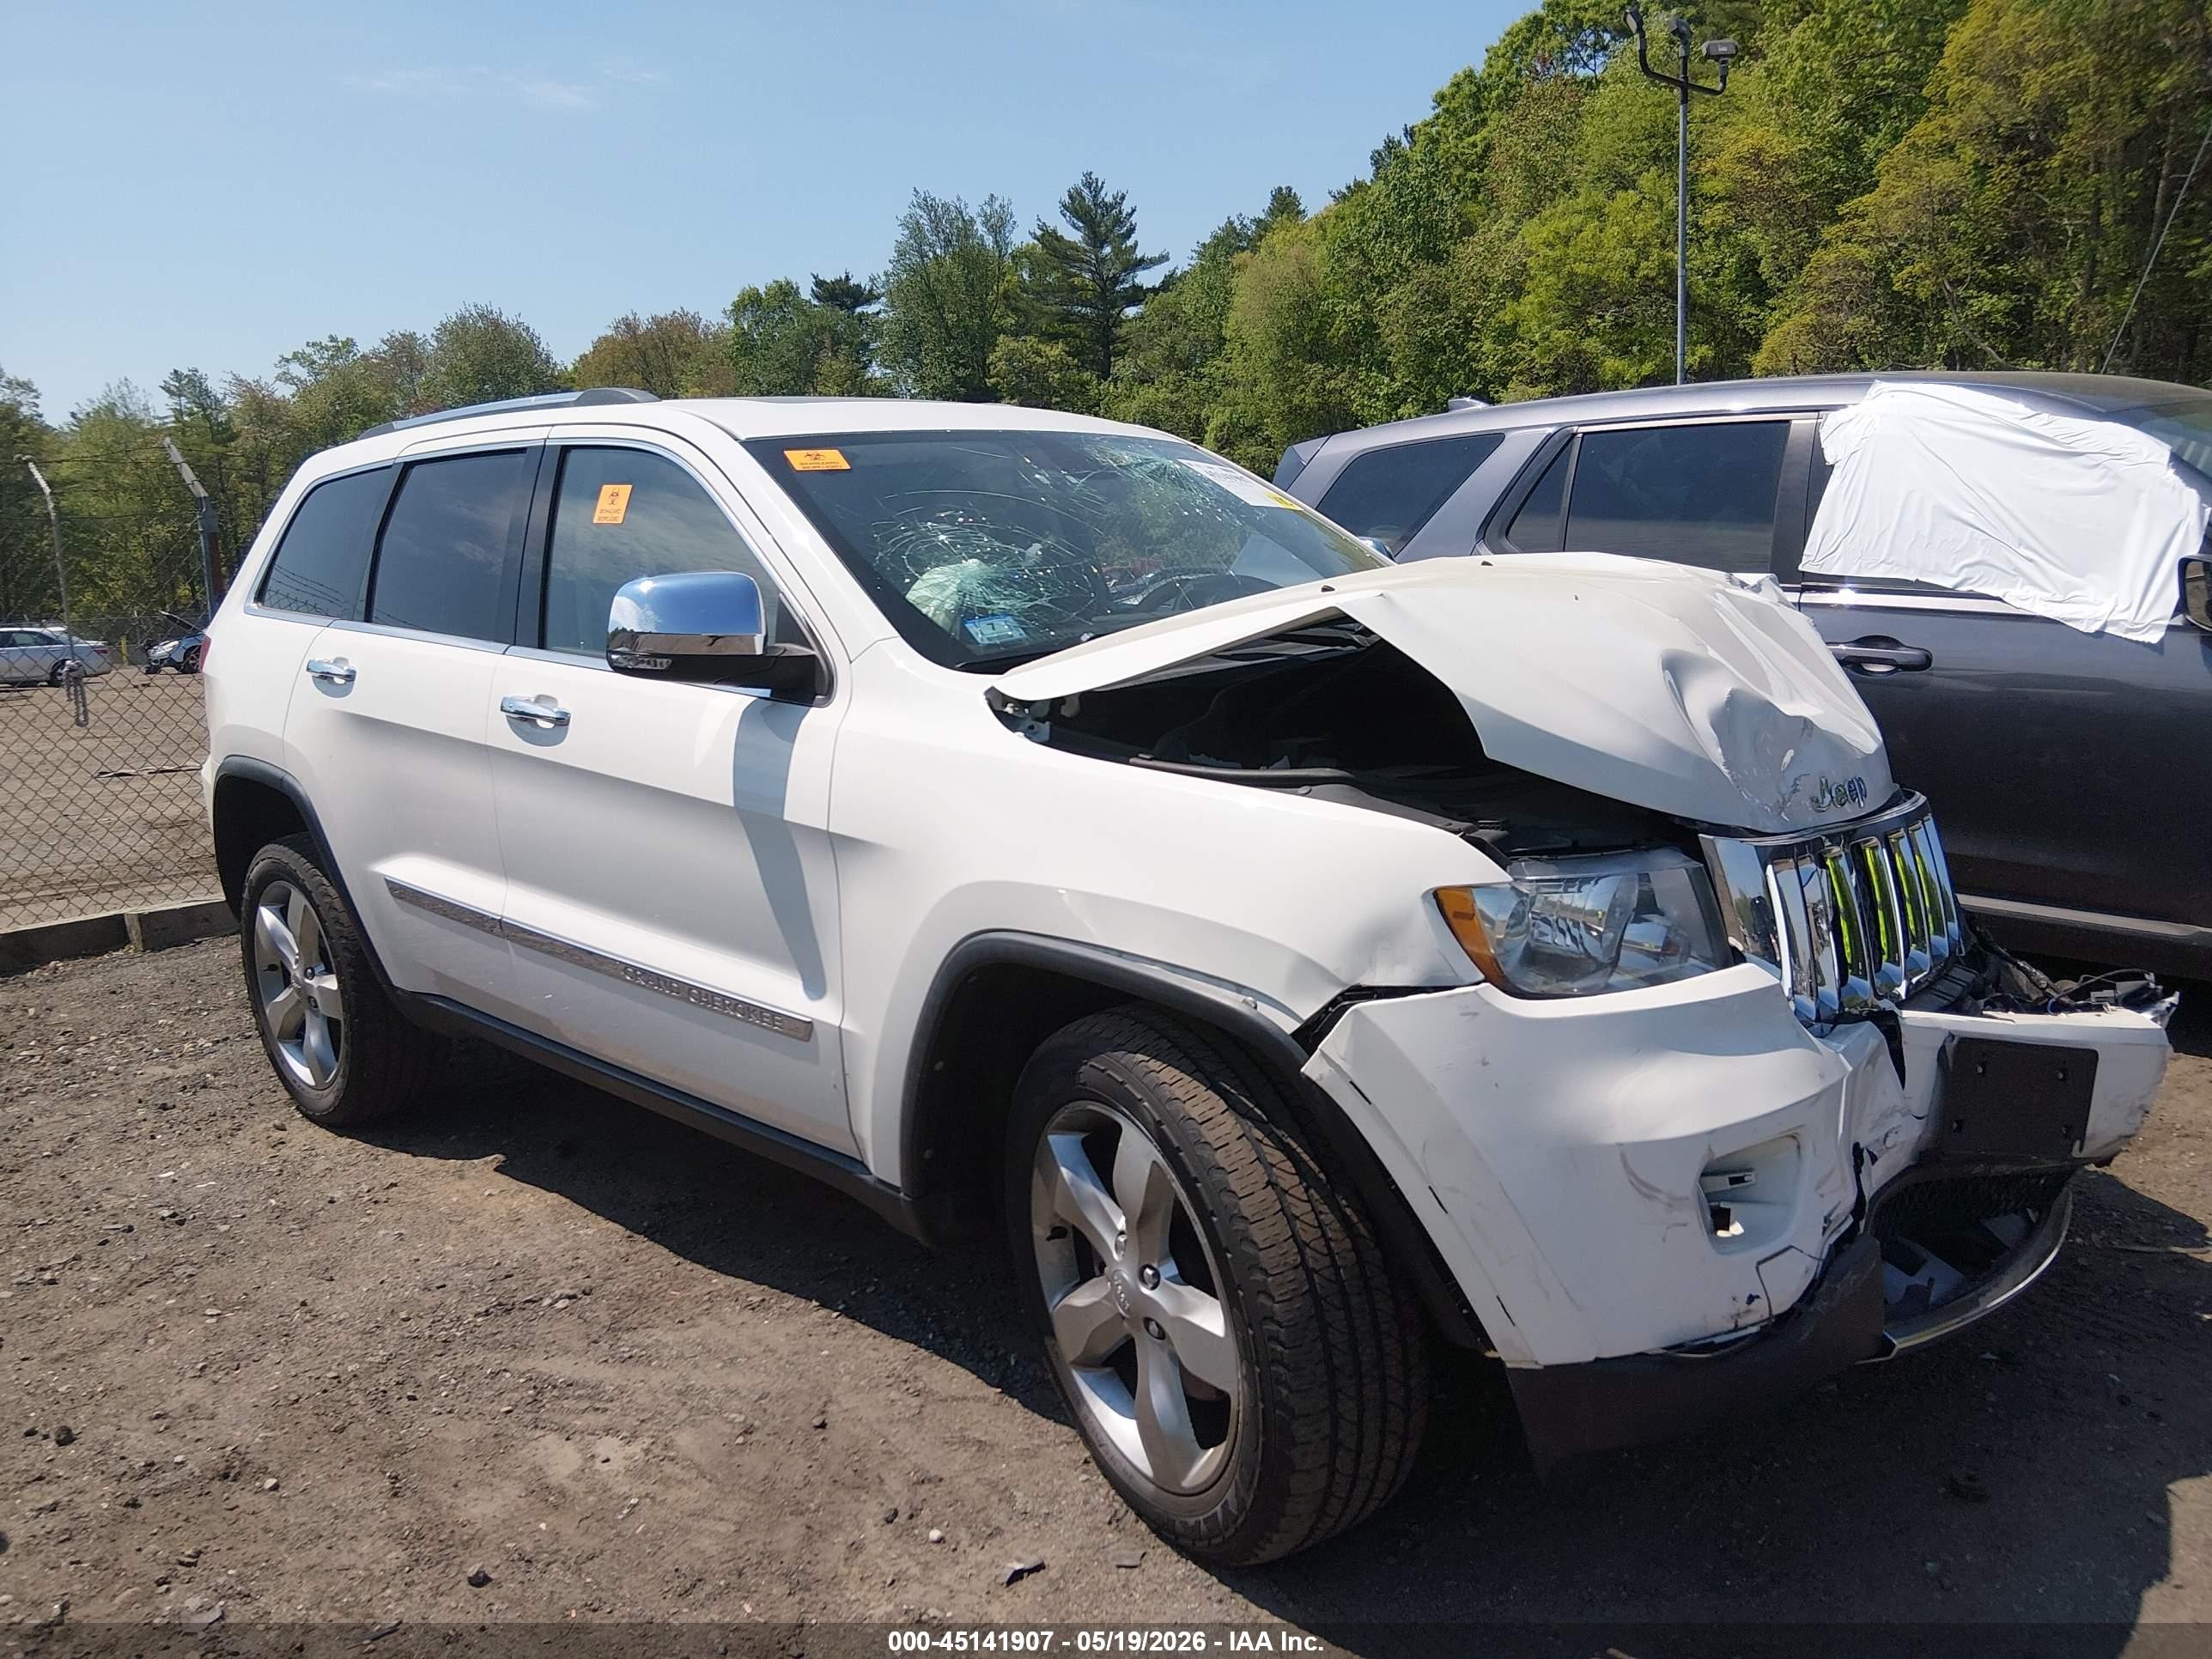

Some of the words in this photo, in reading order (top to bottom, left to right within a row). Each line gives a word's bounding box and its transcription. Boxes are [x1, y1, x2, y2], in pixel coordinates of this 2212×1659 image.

[1810, 775, 1868, 812] Jeep
[622, 966, 681, 996] GRAND
[687, 988, 784, 1030] CHEROKEE
